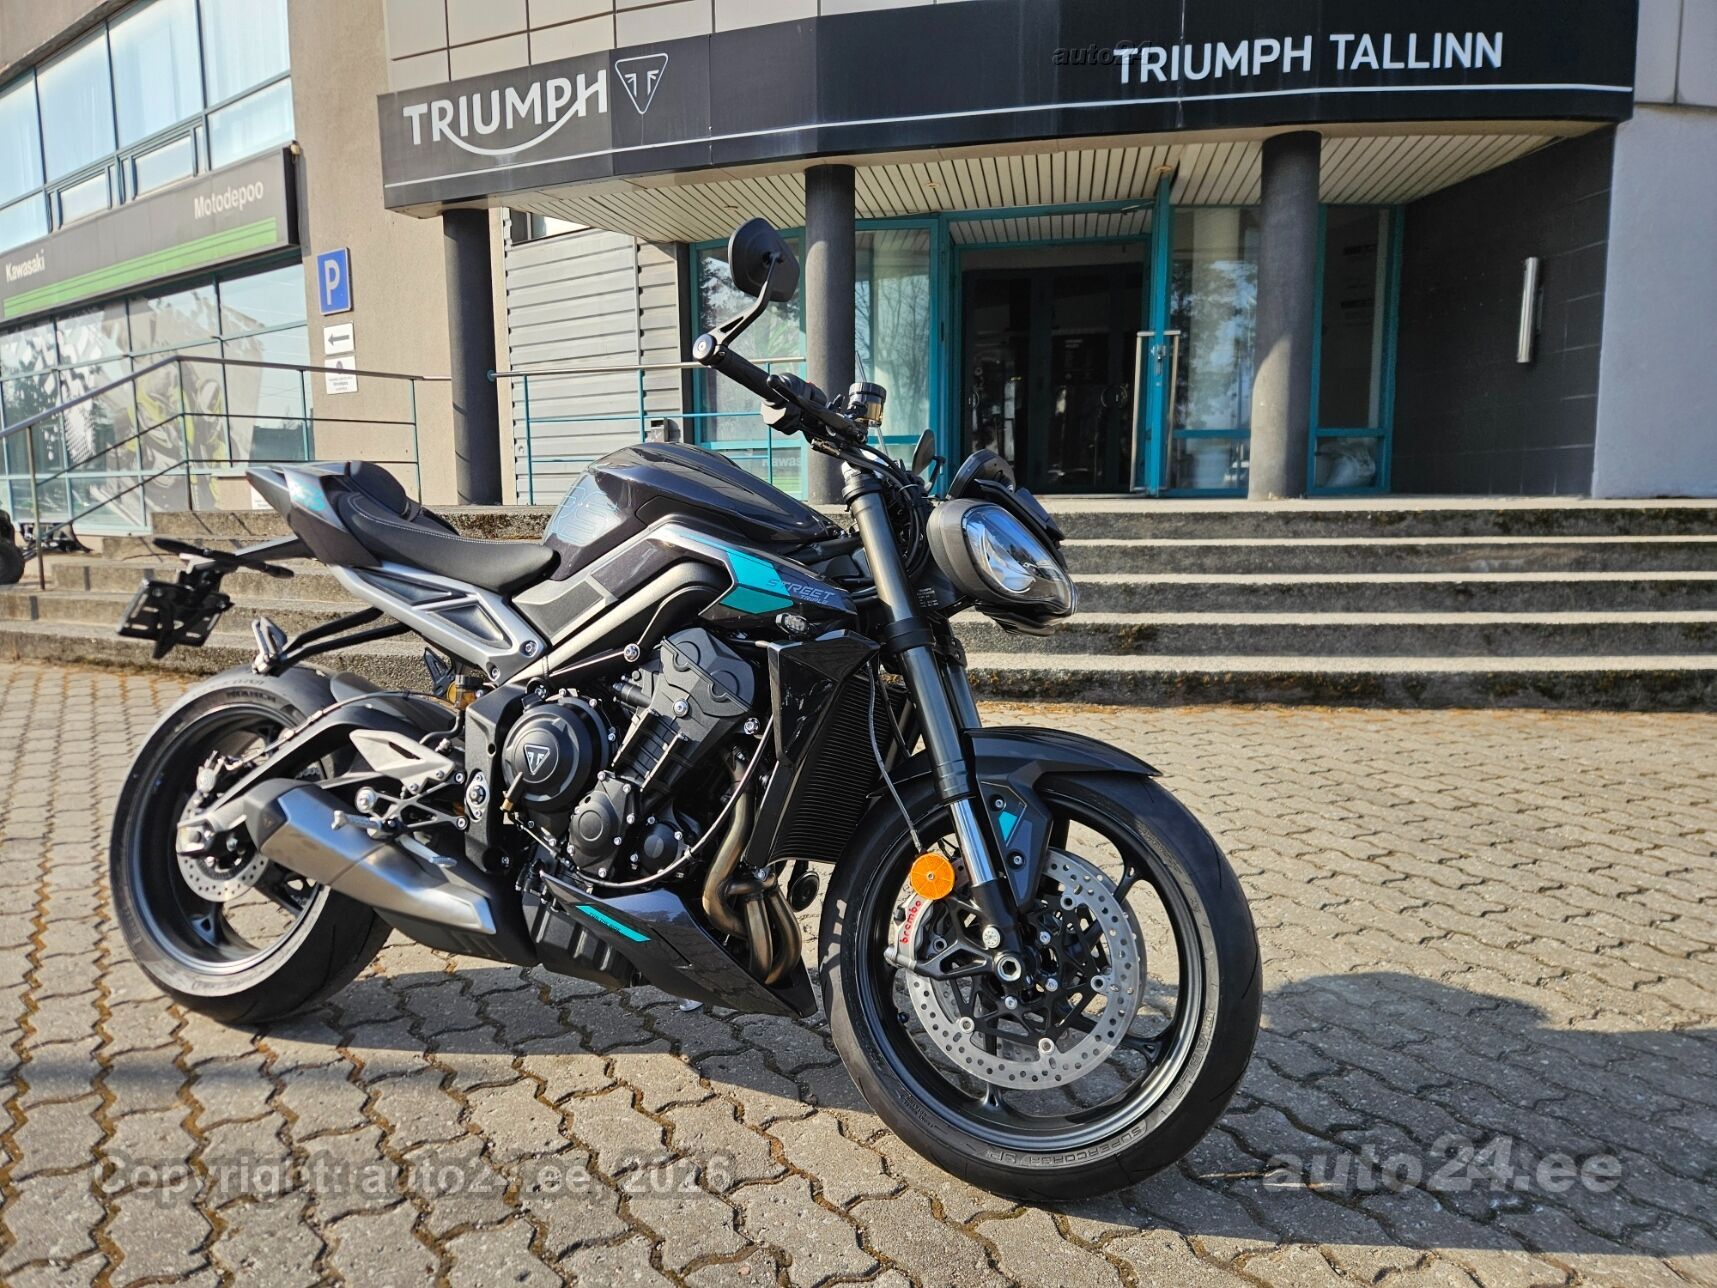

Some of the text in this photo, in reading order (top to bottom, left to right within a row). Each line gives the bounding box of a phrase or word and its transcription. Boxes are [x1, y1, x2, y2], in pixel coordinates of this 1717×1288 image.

[1113, 32, 1503, 84] TRIUMPH TALLINN
[402, 69, 608, 156] TRIUMPH
[194, 181, 264, 219] Motodepoo
[5, 249, 45, 282] Kawasaki
[324, 259, 341, 306] P
[766, 579, 836, 600] STREET
[900, 900, 922, 944] brembo
